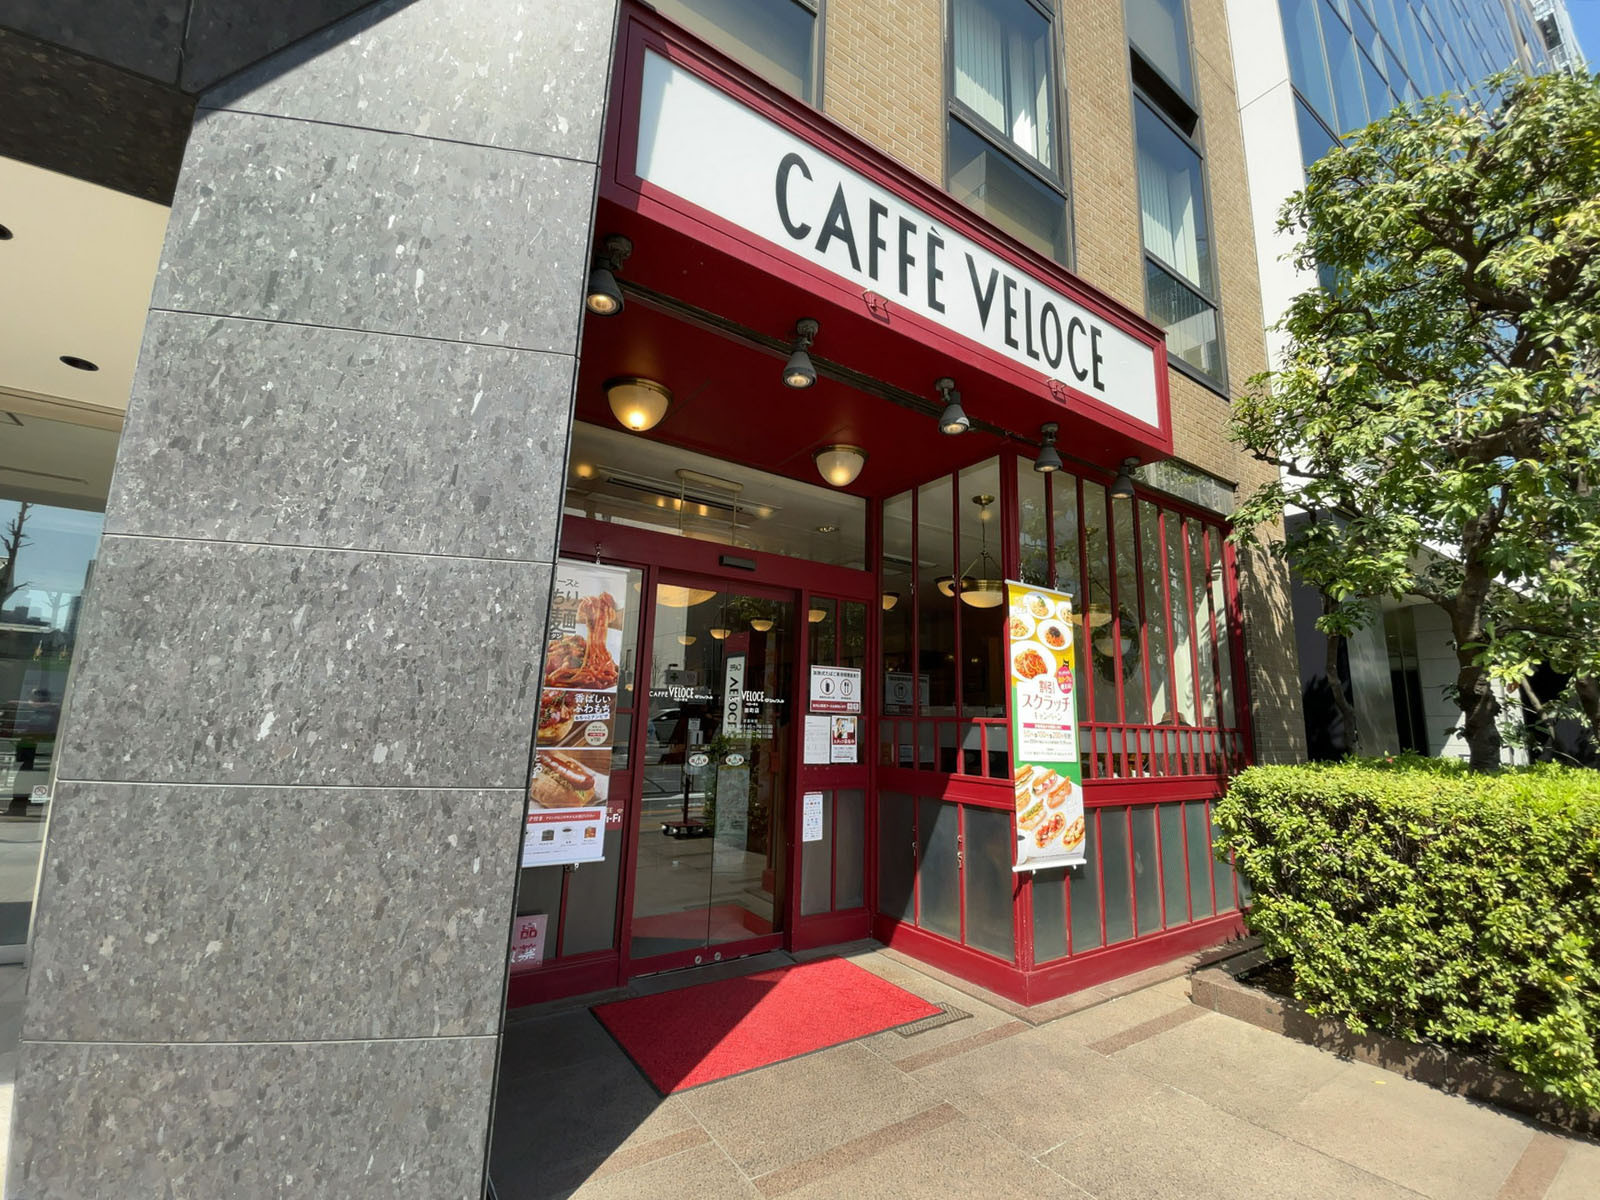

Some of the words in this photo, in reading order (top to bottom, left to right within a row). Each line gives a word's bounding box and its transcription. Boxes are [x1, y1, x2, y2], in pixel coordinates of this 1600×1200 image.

[775, 152, 945, 314] CAFFÈ
[965, 251, 1105, 392] VELOCE
[575, 693, 611, 703] 香ばしい
[668, 686, 695, 699] VELOCE
[741, 690, 765, 703] VELOCE
[1022, 693, 1070, 713] スクラッチ
